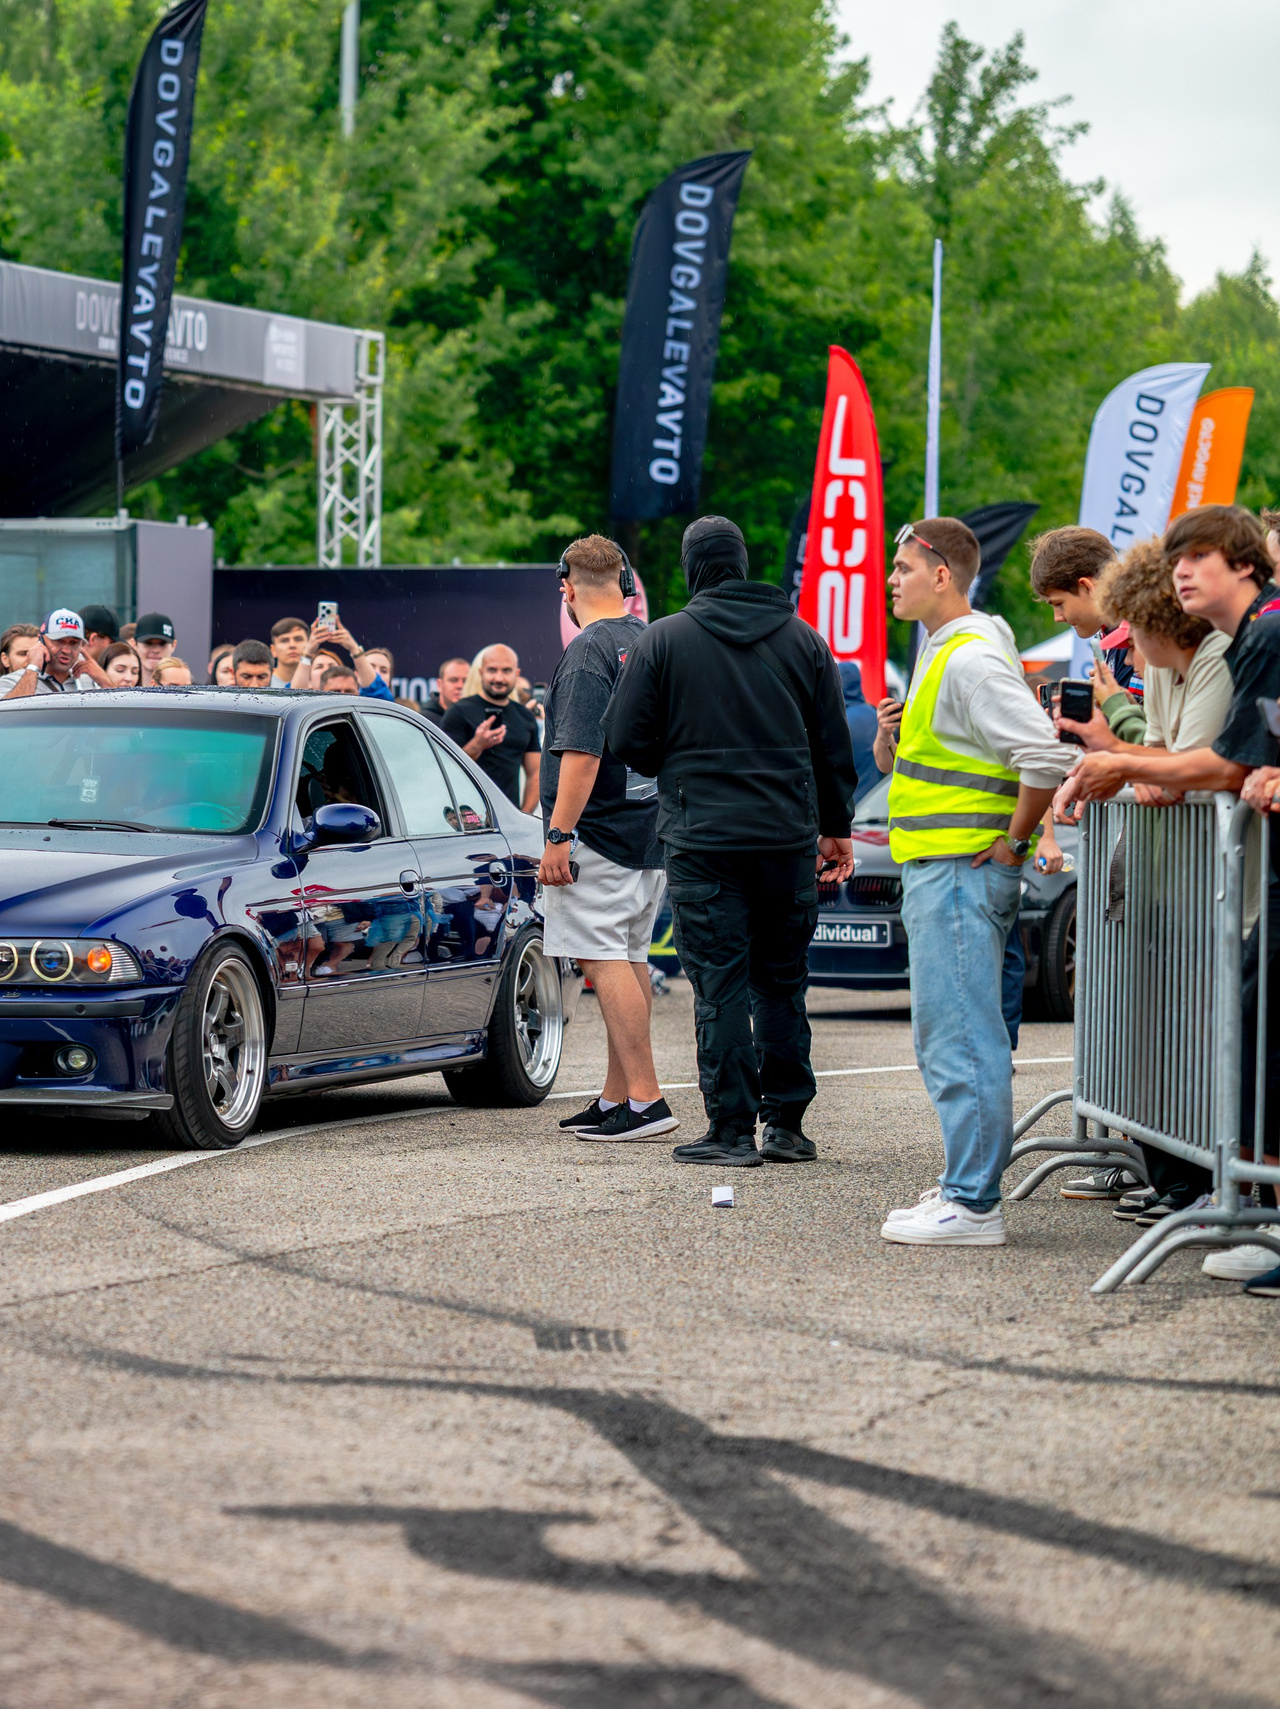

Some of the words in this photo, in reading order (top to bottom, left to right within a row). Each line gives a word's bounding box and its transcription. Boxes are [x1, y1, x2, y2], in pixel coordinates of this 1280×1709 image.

[124, 38, 185, 410] DOVGALEVAVTO
[649, 182, 714, 486] DOVGALEVAVTO
[1110, 392, 1166, 541] DOVGAL
[812, 923, 878, 942] dividual
